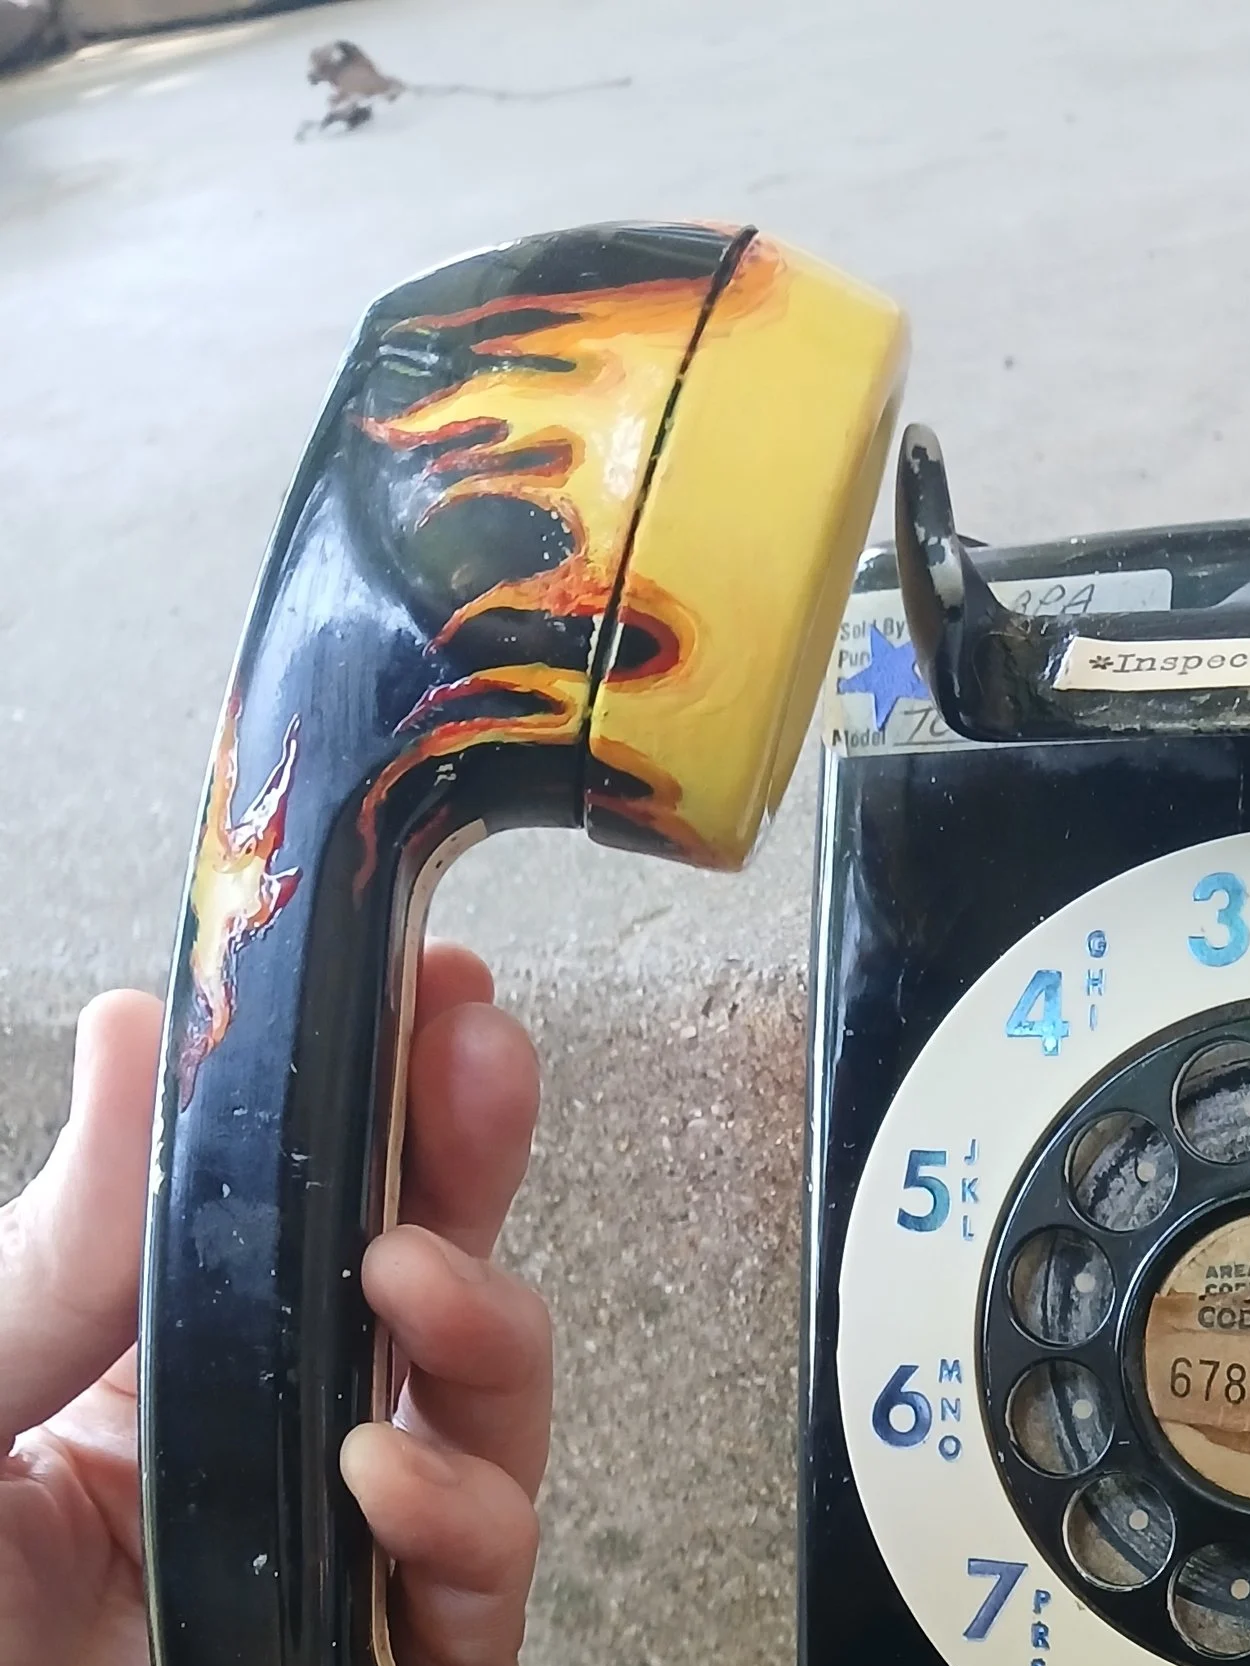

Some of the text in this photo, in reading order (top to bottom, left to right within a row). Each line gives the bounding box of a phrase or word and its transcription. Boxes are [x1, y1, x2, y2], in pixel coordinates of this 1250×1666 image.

[840, 618, 877, 641] Sol
[831, 727, 886, 747] Model
[1187, 871, 1250, 967] 3
[1006, 969, 1070, 1056] 4
[897, 1150, 950, 1232] 5
[872, 1365, 932, 1447] 6
[963, 1558, 1028, 1640] 7
